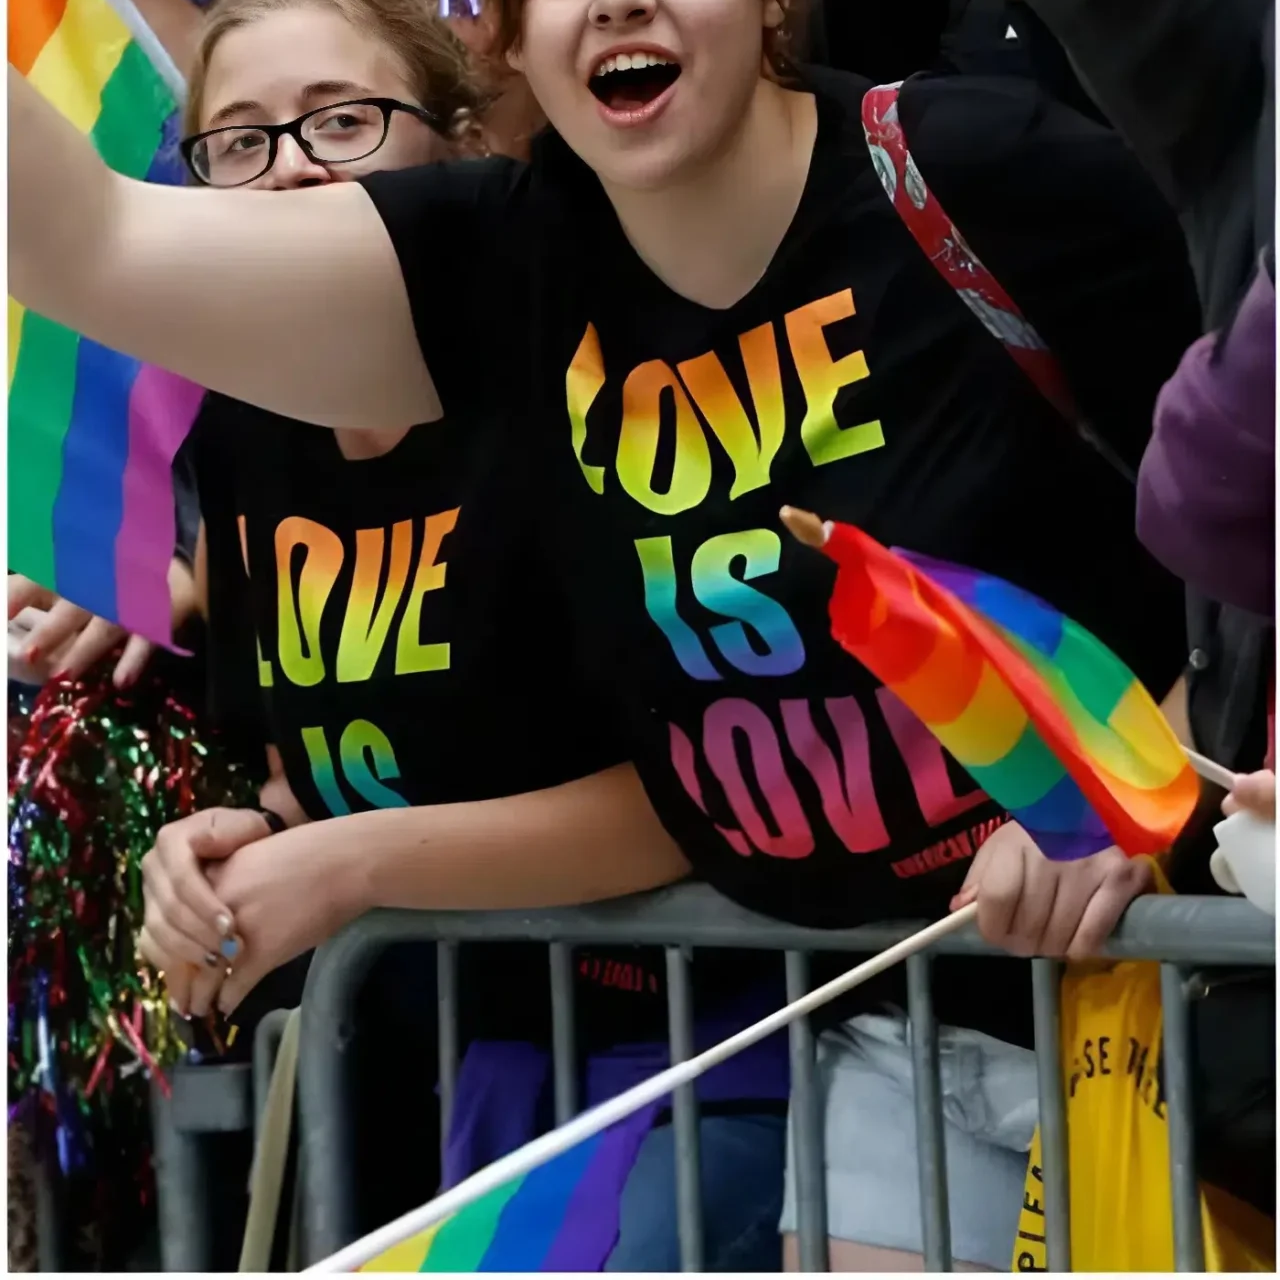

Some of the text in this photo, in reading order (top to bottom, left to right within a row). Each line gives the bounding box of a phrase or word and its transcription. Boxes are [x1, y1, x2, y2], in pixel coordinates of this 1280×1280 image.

[566, 288, 885, 515] LOVE
[237, 506, 461, 687] OVE
[634, 528, 805, 680] IS
[301, 719, 411, 816] IS
